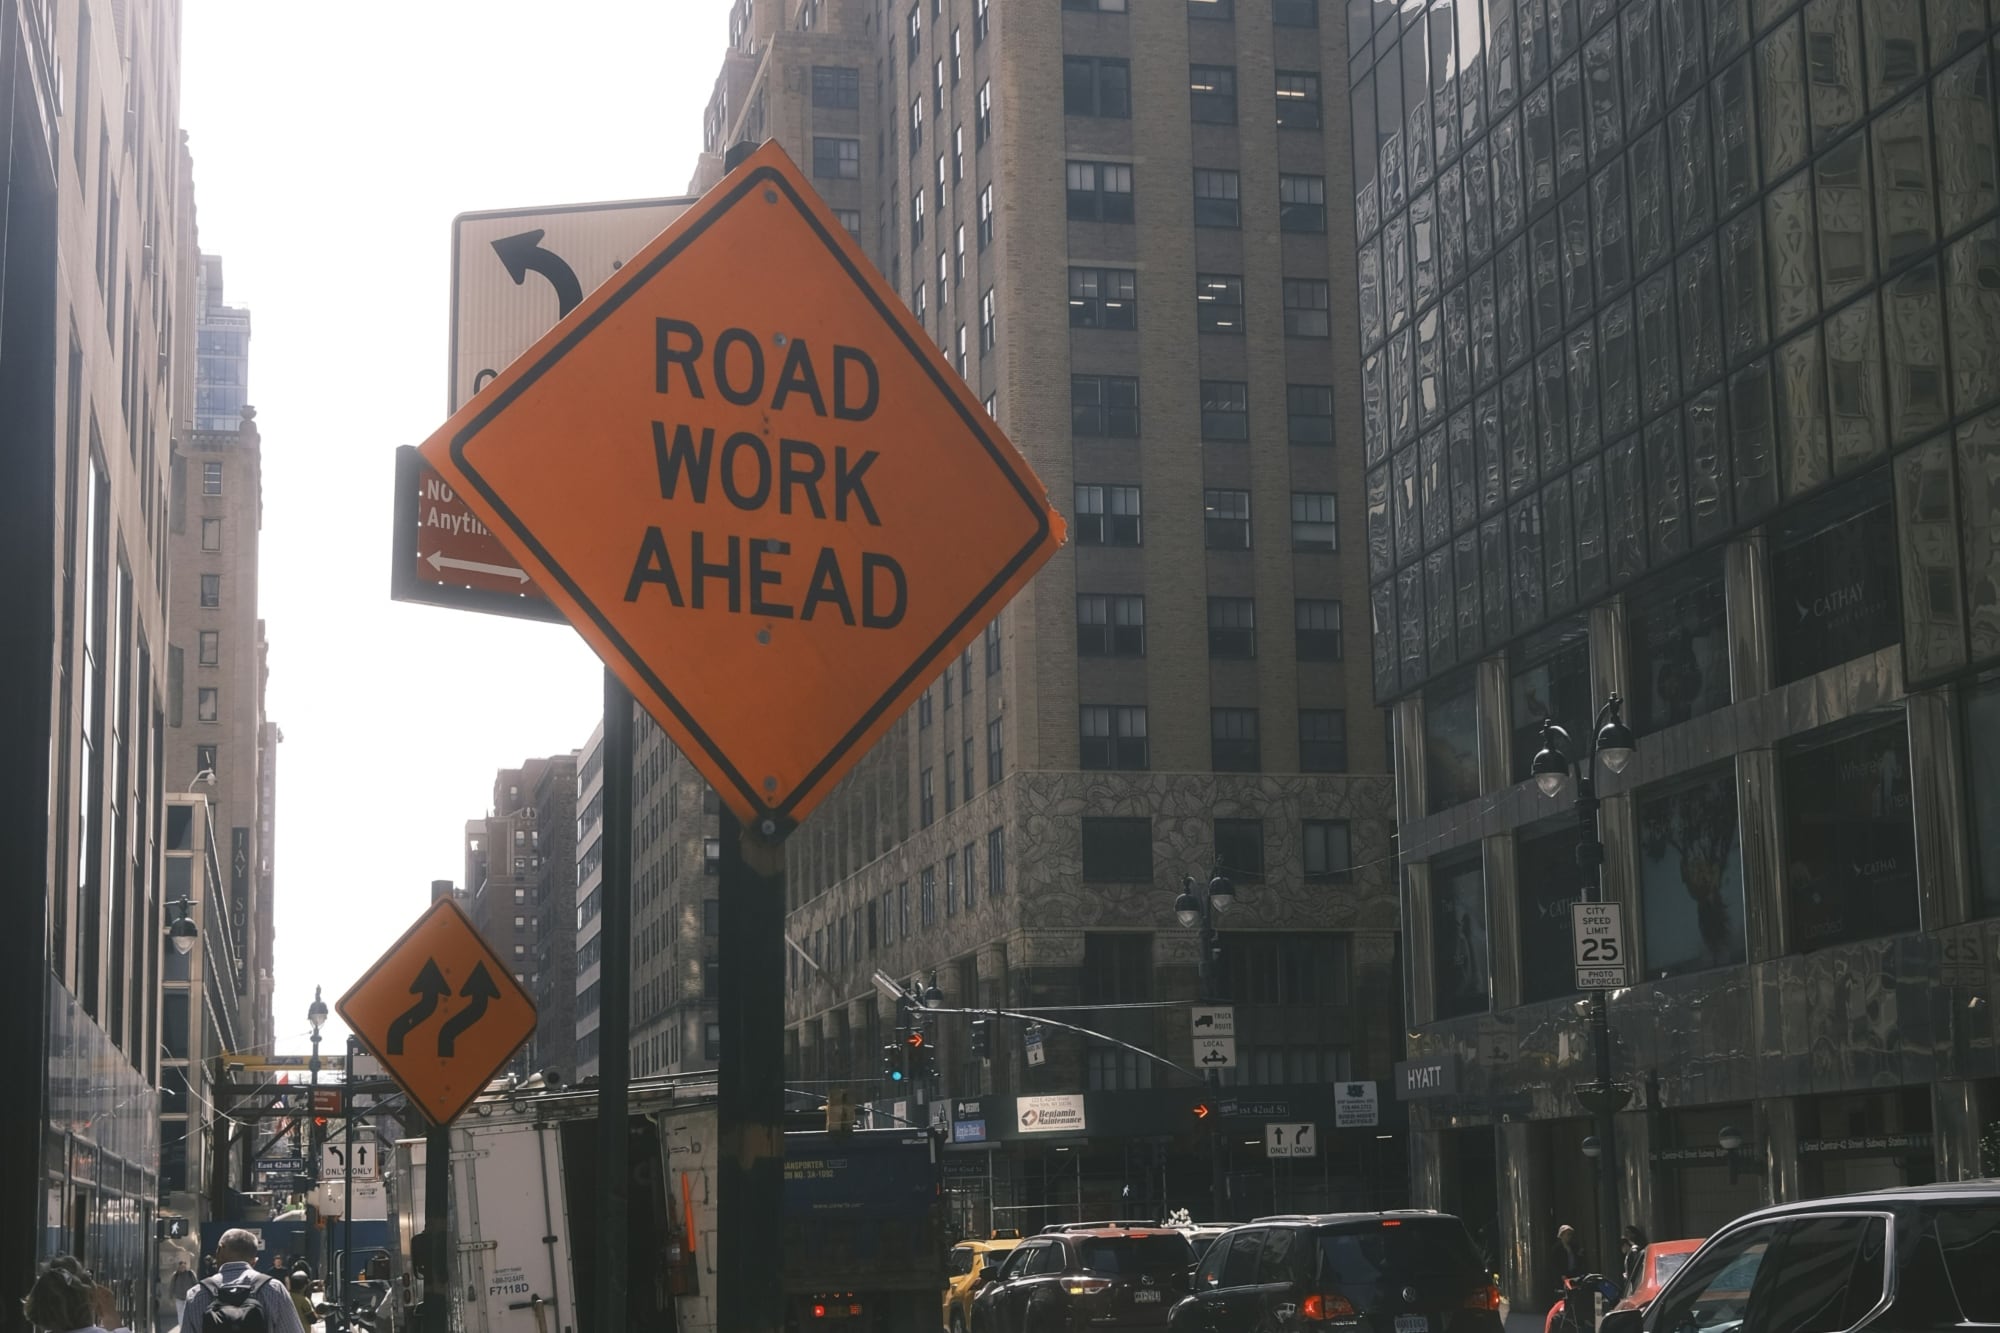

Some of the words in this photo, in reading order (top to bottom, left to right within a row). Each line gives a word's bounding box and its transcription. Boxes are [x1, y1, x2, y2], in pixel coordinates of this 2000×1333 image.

[655, 316, 880, 422] ROAD
[651, 420, 882, 527] WORK
[427, 479, 453, 503] NO
[427, 506, 492, 537] Anyti
[624, 525, 908, 629] AHEAD
[1813, 580, 1864, 617] CATHAY
[234, 832, 246, 878] JAY
[1586, 907, 1606, 915] CITY
[1582, 917, 1611, 925] SPEED
[1586, 927, 1609, 935] LIMIT
[233, 897, 246, 990] SUITS
[1582, 938, 1618, 961] 25
[1581, 978, 1621, 986] ENFORCED
[1407, 1065, 1442, 1090] HYATT
[1039, 1109, 1076, 1118] Benjamin
[1253, 1104, 1274, 1114] 42nd
[1277, 1104, 1287, 1114] St
[1039, 1116, 1082, 1125] Maintenance
[257, 1161, 273, 1169] East
[274, 1160, 291, 1169] 42nd
[292, 1160, 301, 1169] St
[351, 1167, 372, 1175] ONLY
[490, 1283, 529, 1296] F7118D
